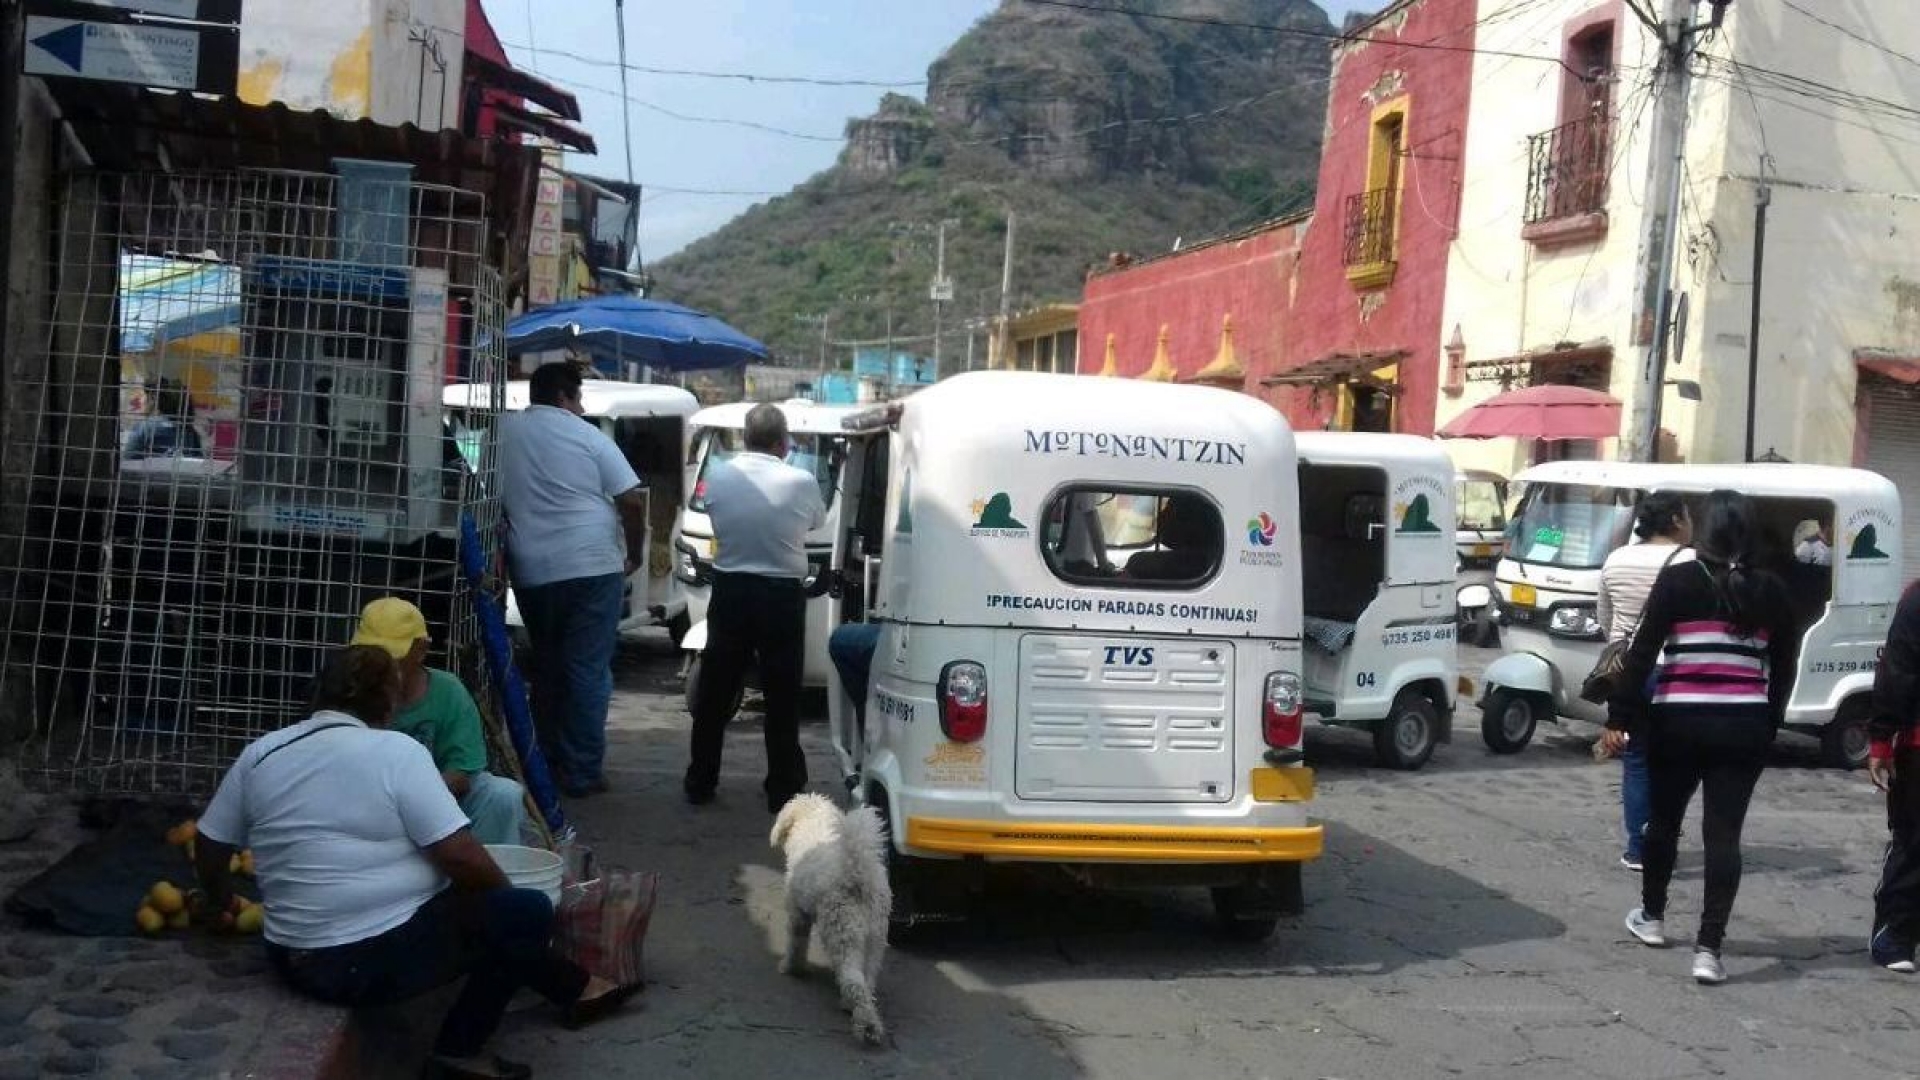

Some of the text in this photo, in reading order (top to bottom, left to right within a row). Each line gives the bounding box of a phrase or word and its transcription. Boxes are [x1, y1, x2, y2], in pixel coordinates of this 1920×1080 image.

[1098, 600, 1165, 617] PARADAS
[1170, 604, 1258, 623] CONTINUAS!
[1389, 633, 1409, 645] 735
[1412, 630, 1431, 643] 250
[1103, 645, 1155, 666] TVS
[1356, 671, 1376, 688] 04
